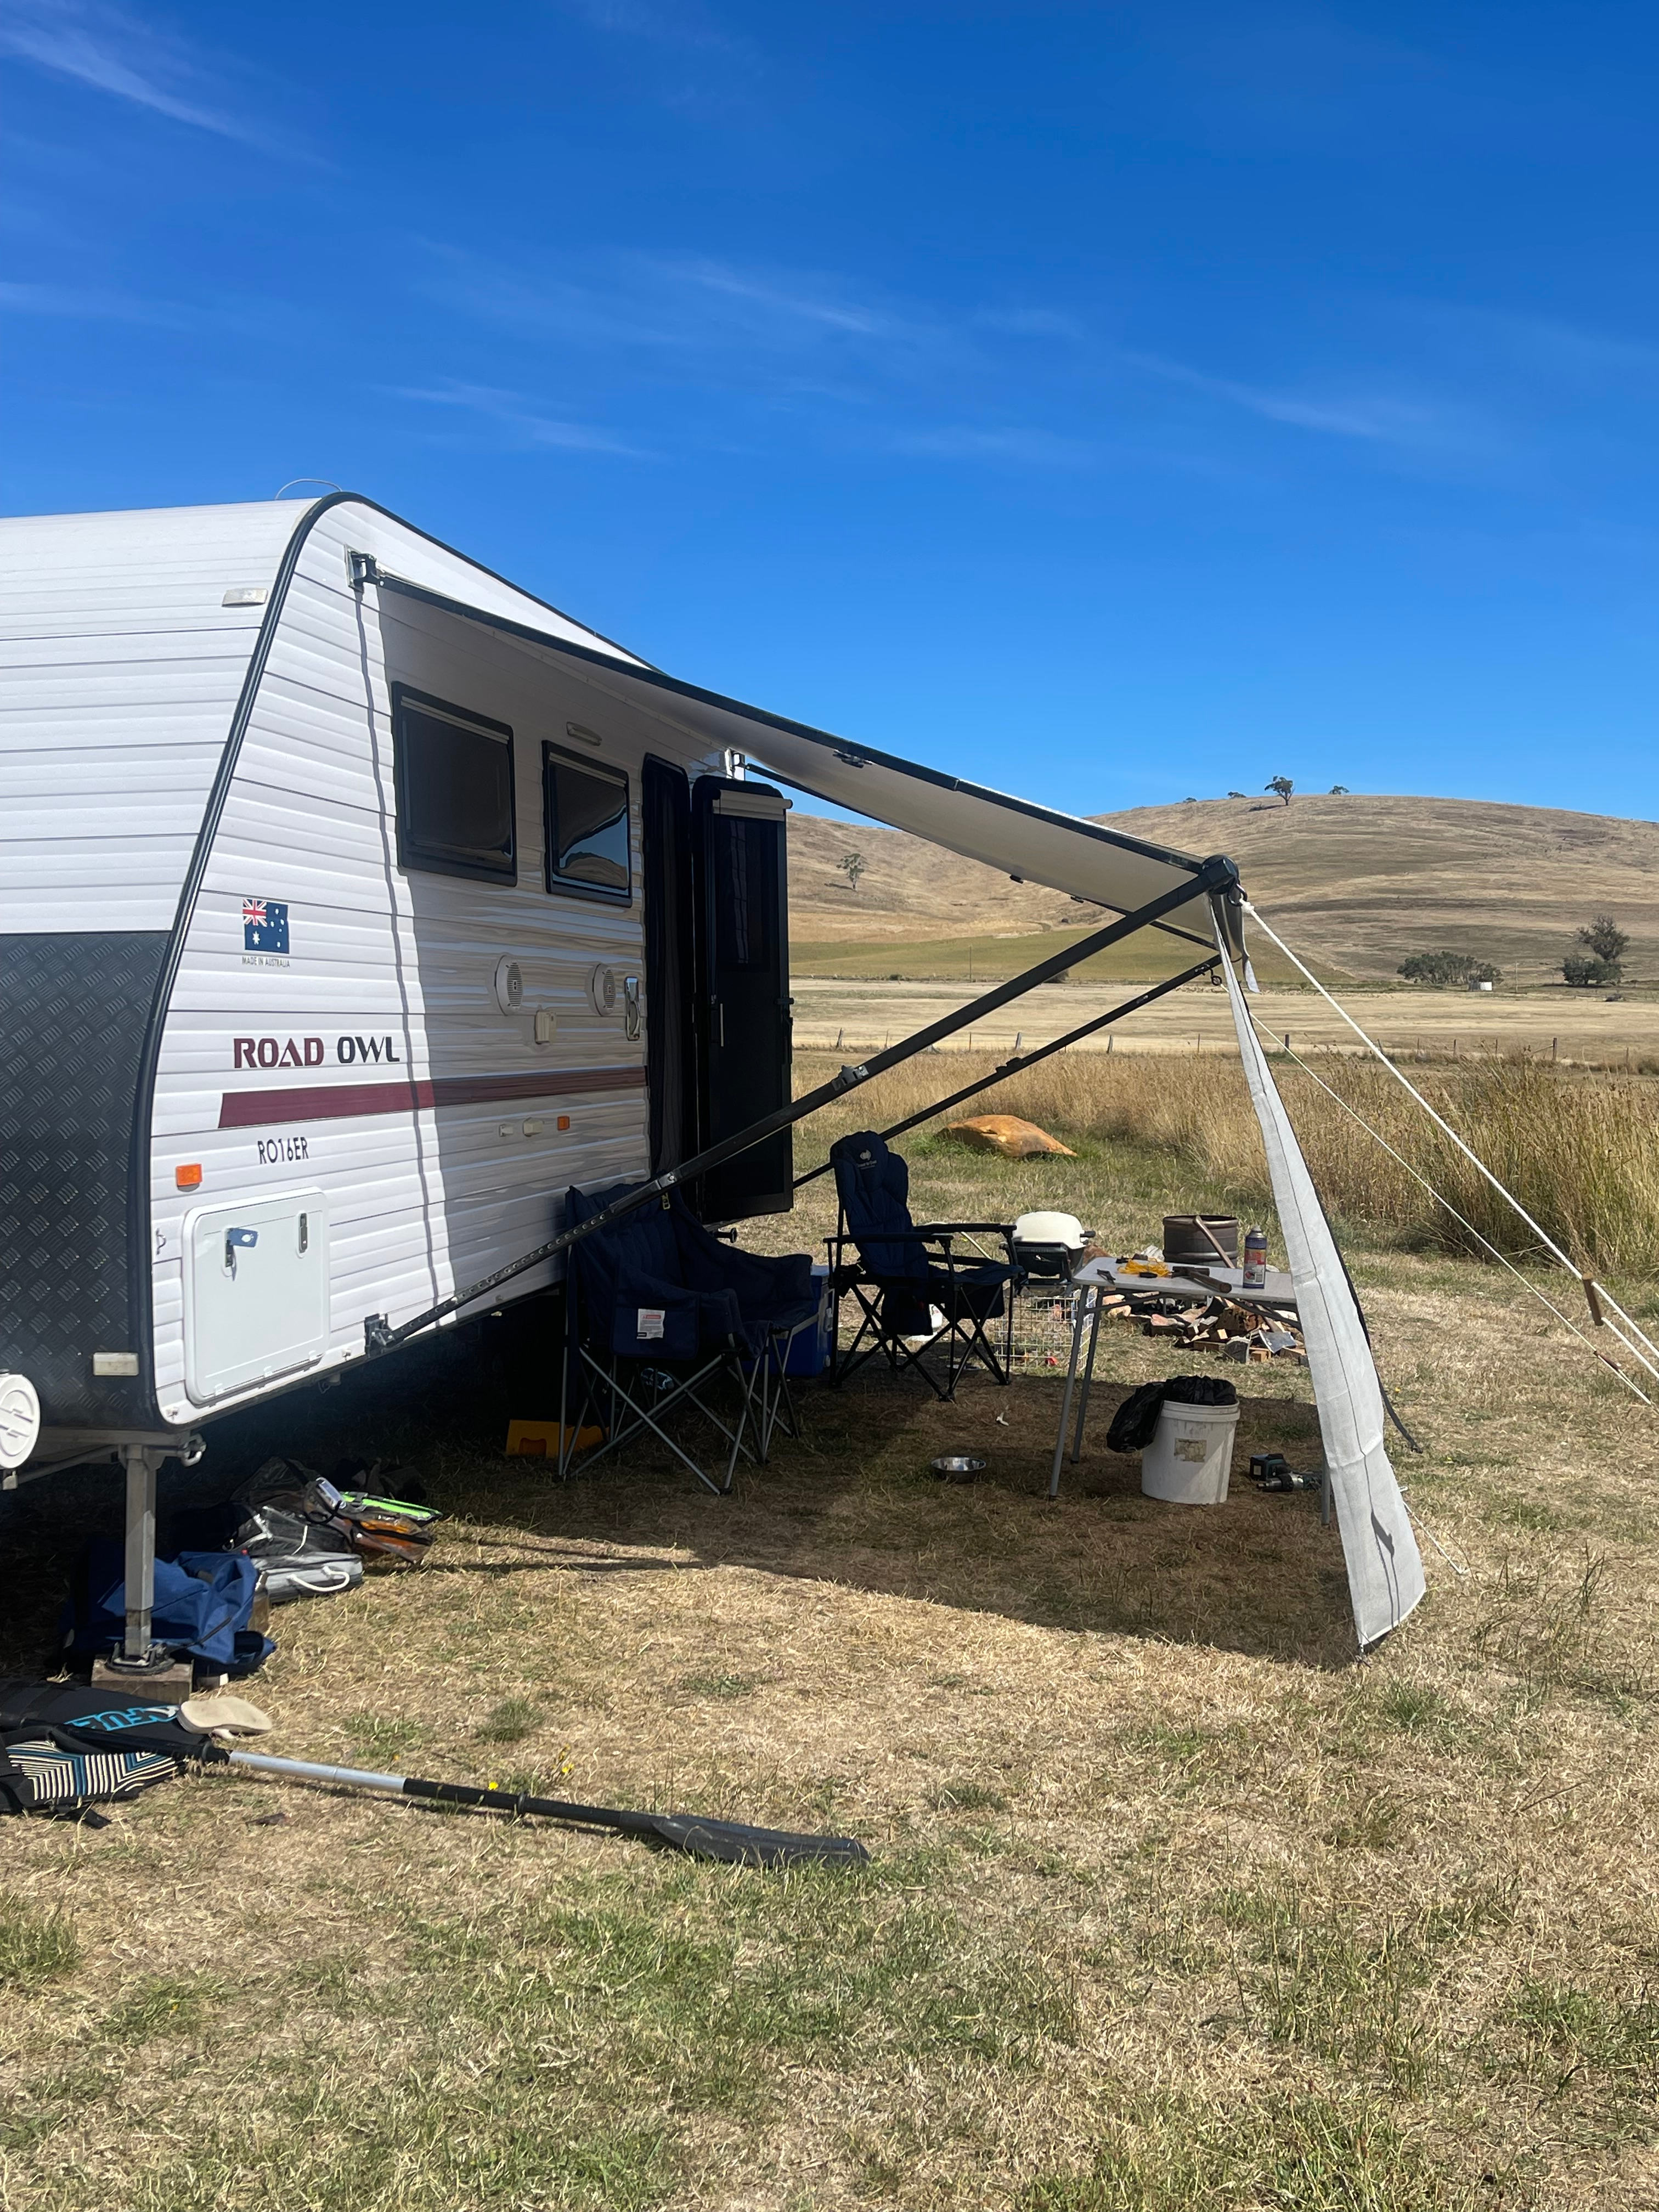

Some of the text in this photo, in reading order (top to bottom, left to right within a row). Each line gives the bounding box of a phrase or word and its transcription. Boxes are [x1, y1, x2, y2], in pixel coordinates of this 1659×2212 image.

[242, 956, 290, 967] MADE IN AUSTRALIA
[233, 1036, 400, 1068] ROAD OWL
